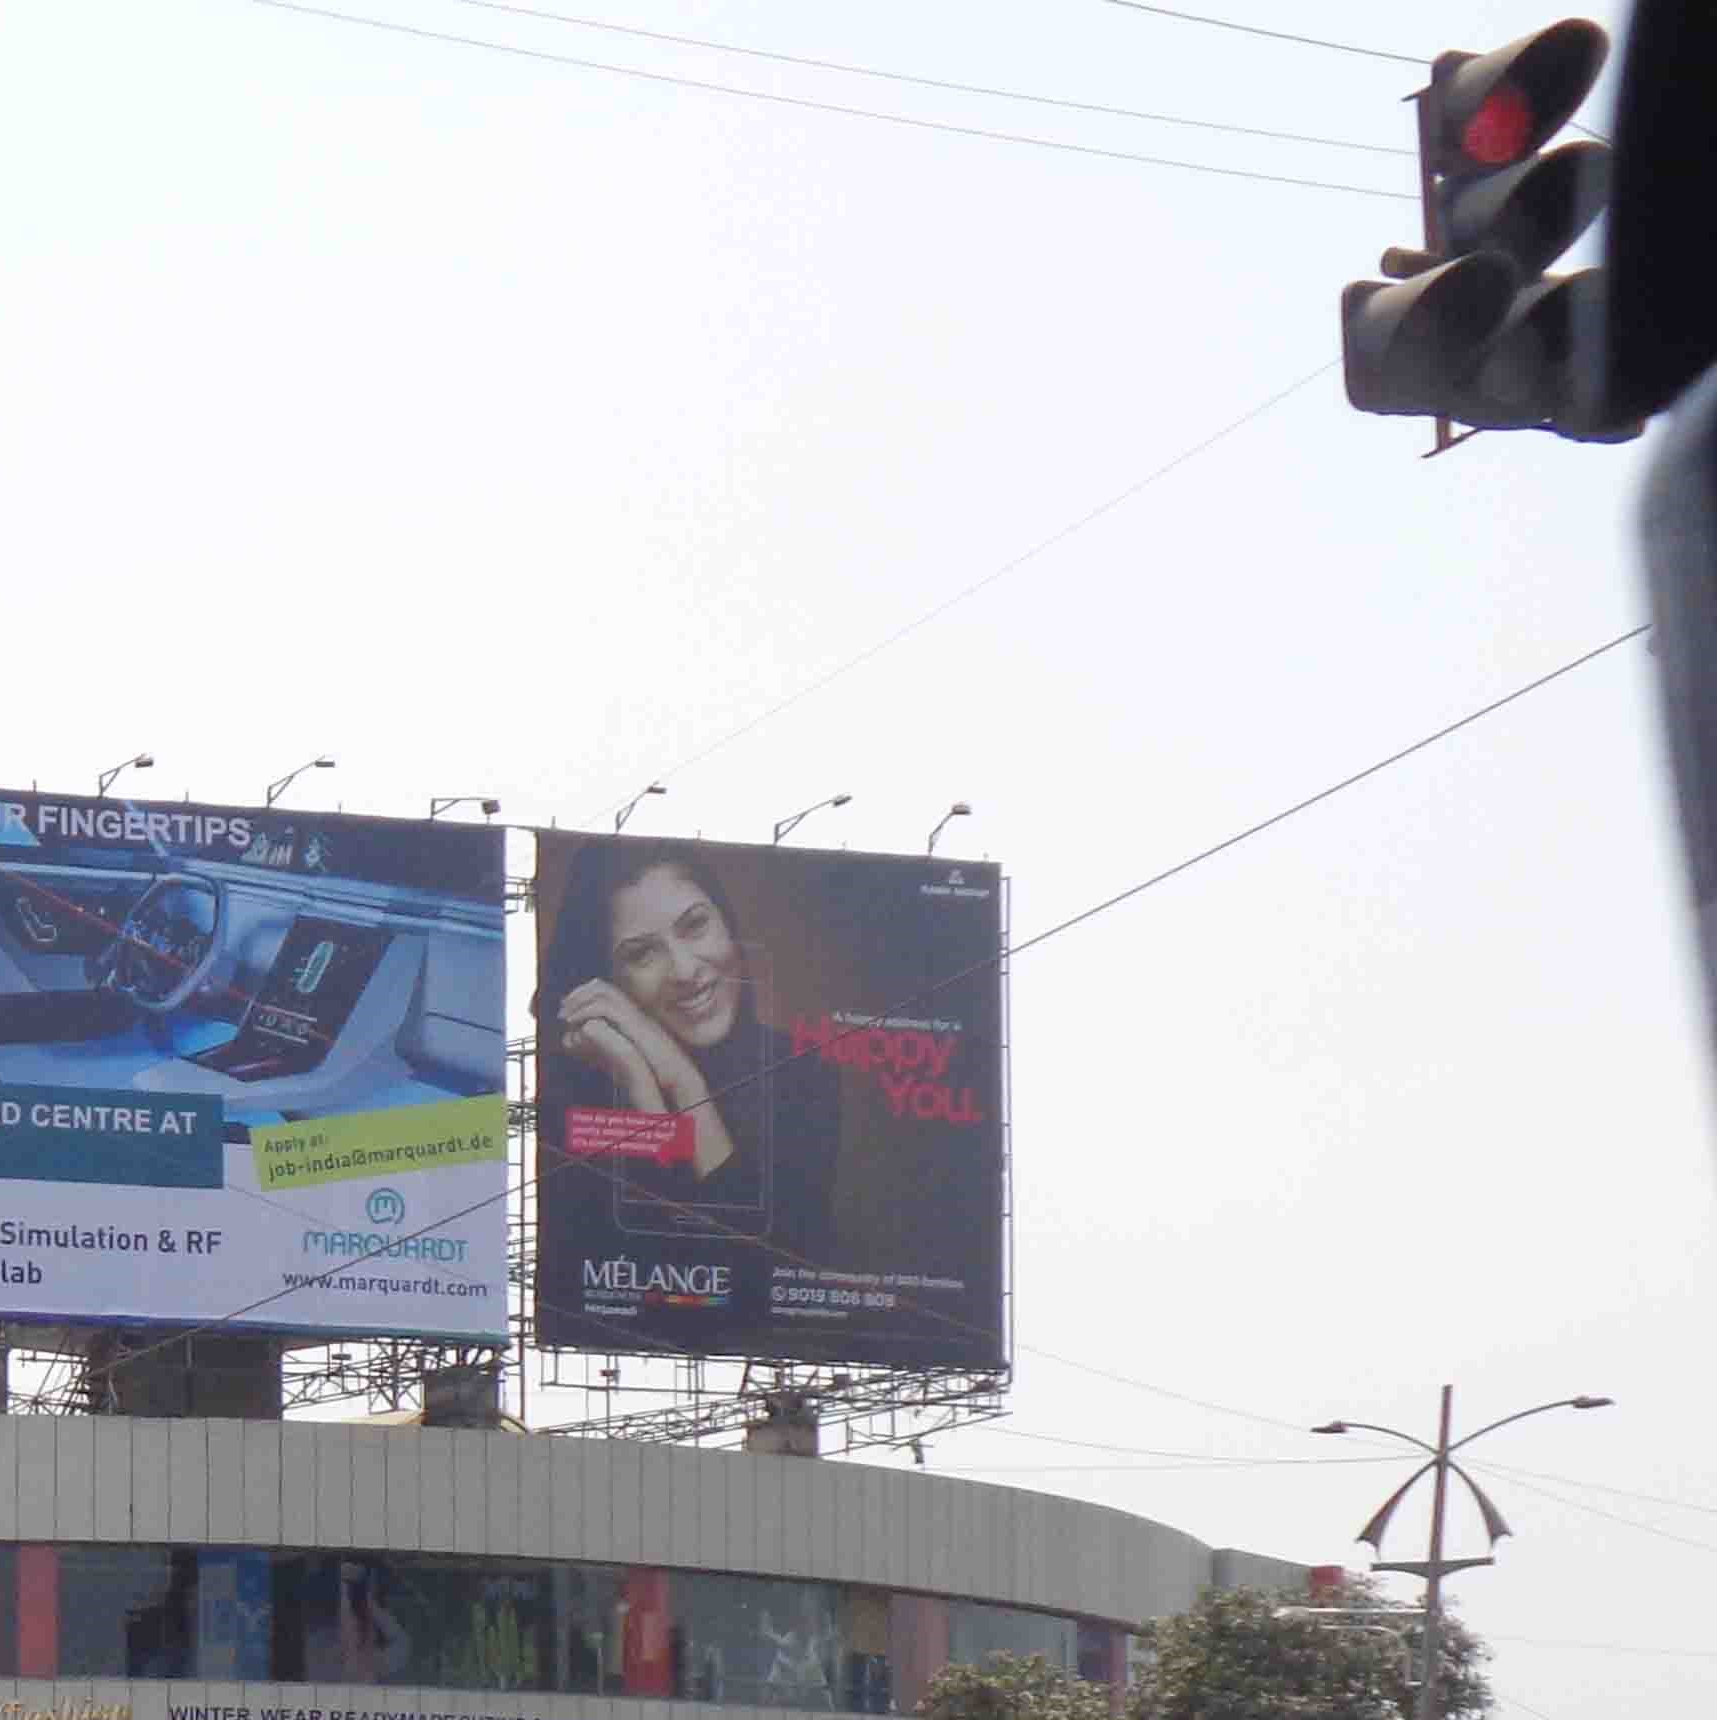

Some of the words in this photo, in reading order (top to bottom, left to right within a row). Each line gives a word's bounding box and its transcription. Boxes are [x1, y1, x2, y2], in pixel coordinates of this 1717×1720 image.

[38, 805, 252, 848] FINGERTIPS
[31, 1104, 151, 1133] CENTRE
[159, 1110, 197, 1135] AT
[268, 1133, 493, 1183] job-india@marquardt.de
[0, 1221, 149, 1254] Simulation
[158, 1230, 177, 1255] &
[186, 1230, 223, 1256] RF
[303, 1231, 468, 1262] MARQUARDT
[282, 1271, 488, 1298] www.marquardt.com
[583, 1254, 732, 1295] MÉLANGE
